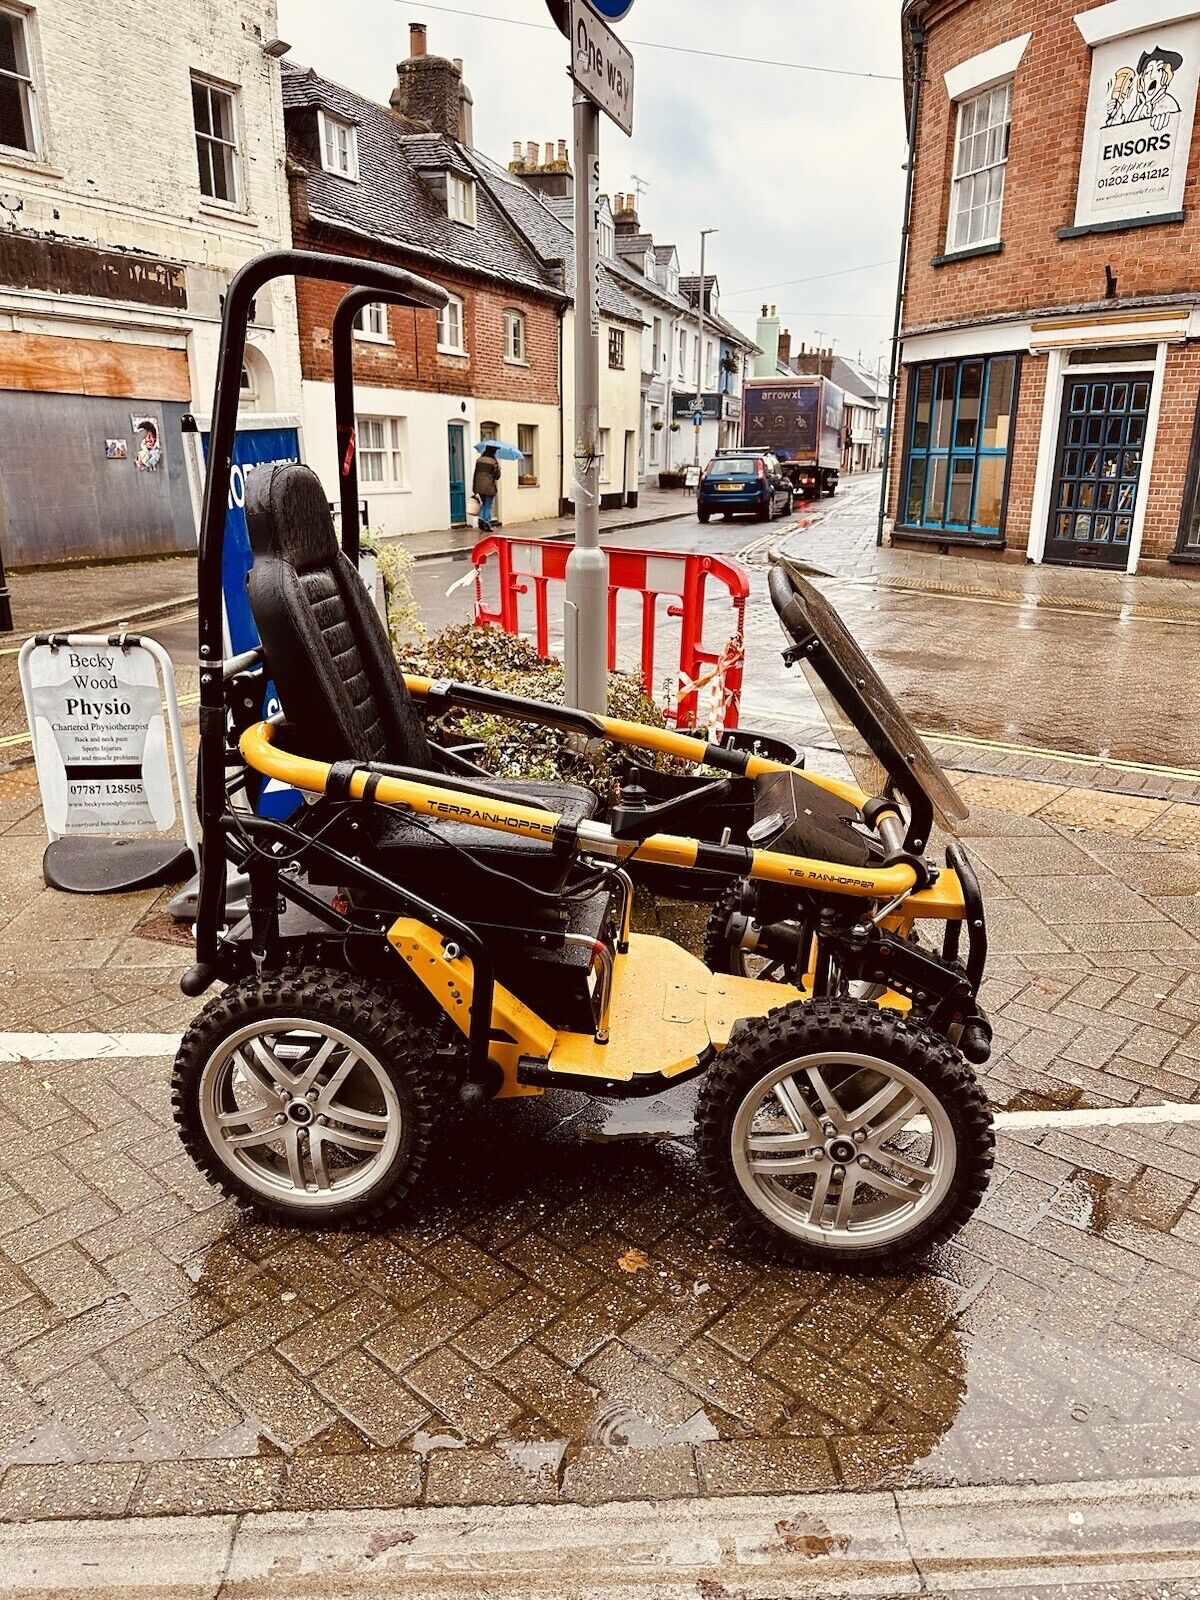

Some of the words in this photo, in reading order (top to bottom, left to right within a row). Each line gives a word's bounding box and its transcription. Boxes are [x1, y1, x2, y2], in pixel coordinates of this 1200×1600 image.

[577, 17, 603, 77] One
[606, 58, 630, 111] way
[1103, 133, 1171, 161] ENSORS
[1098, 174, 1129, 189] 01202
[1131, 167, 1170, 183] 841212
[761, 389, 802, 400] arrowxl
[69, 653, 114, 671] Becky
[72, 675, 118, 689] Wood
[65, 698, 131, 720] Physio
[51, 723, 89, 732] Chartered
[91, 723, 149, 732] Physiotherapist
[70, 785, 101, 795] 07787
[105, 784, 143, 794] 128505
[427, 799, 556, 836] TERRAINHOPPE
